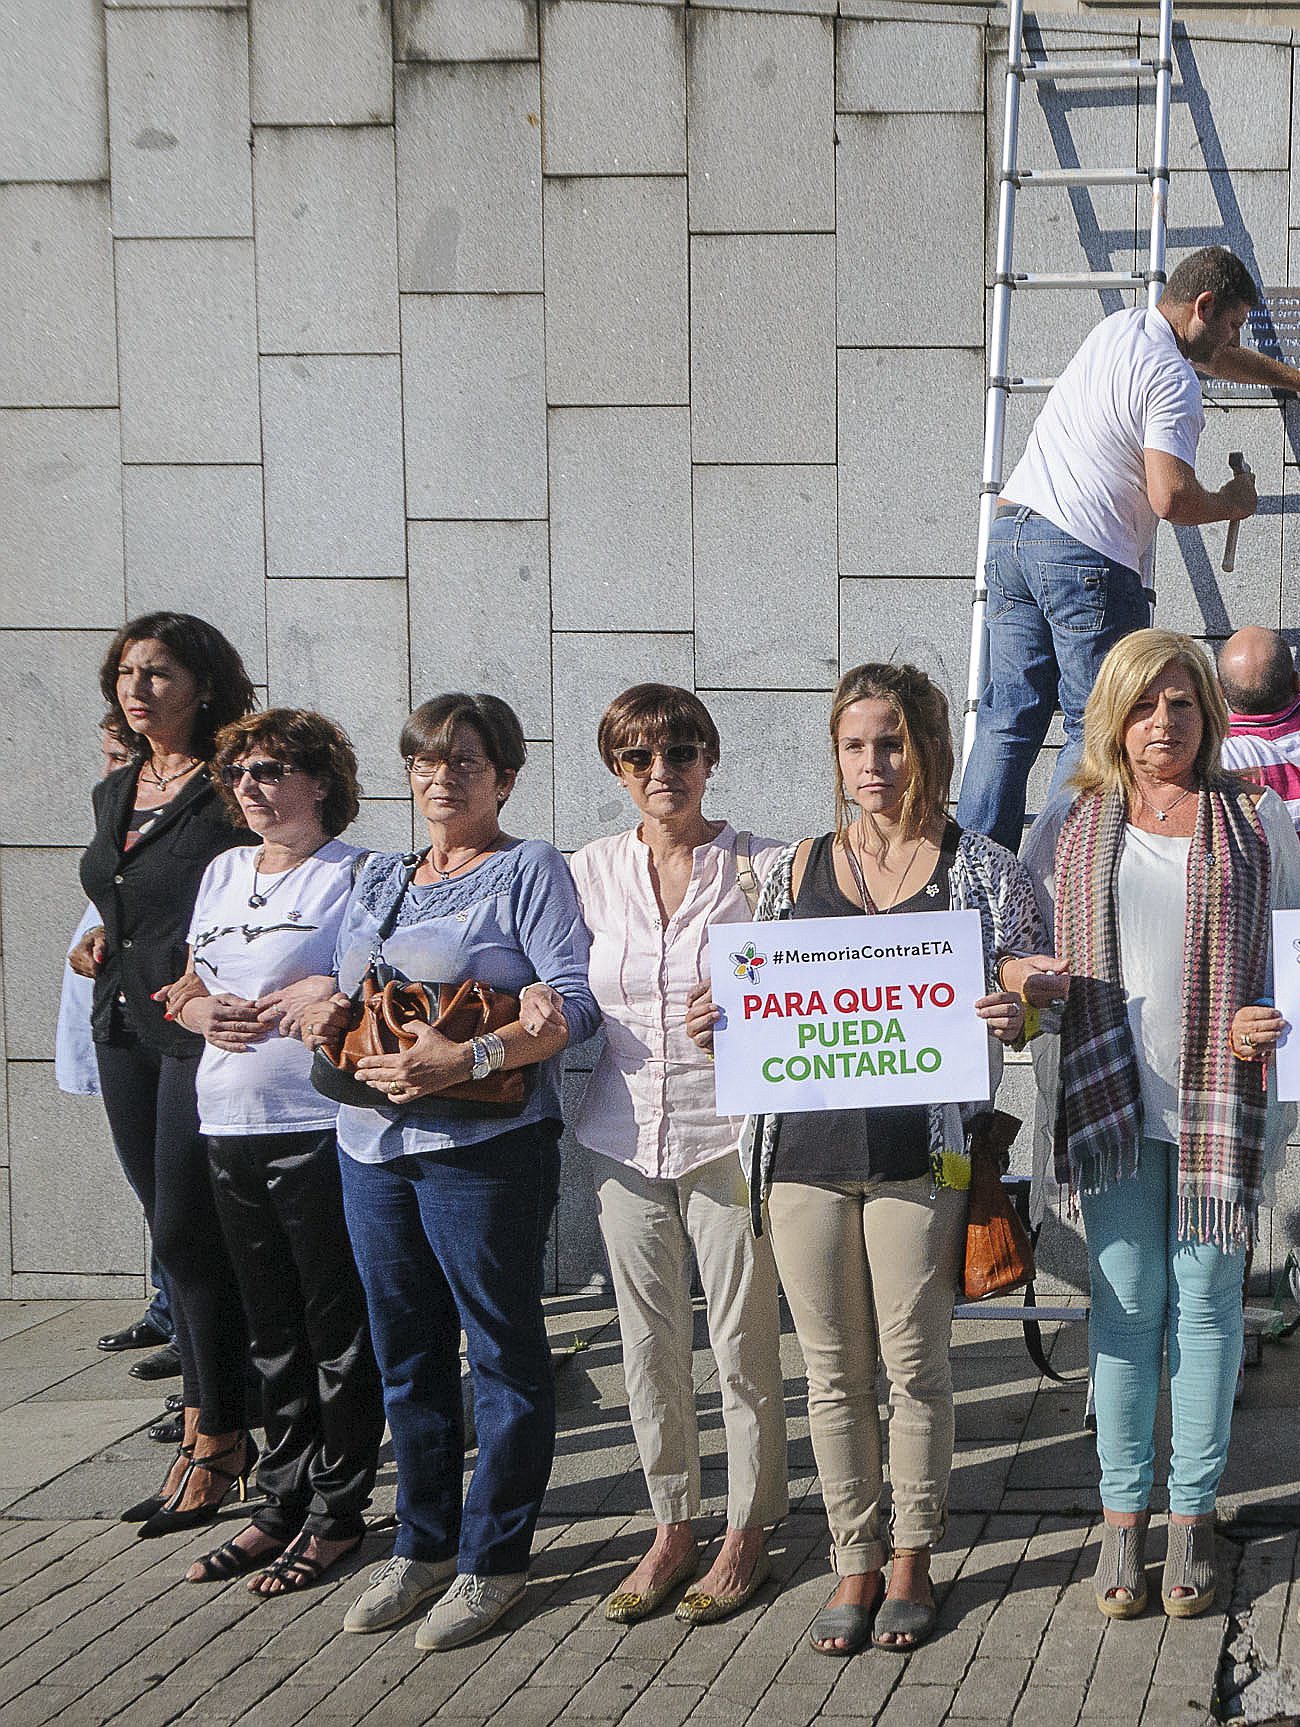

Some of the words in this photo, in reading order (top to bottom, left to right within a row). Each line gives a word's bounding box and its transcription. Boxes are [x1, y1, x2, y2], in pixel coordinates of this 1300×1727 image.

[773, 940, 954, 965] #MemoriaContraETA
[744, 990, 828, 1020] PARA
[834, 985, 903, 1013] QUE
[908, 982, 955, 1009] YO
[798, 1018, 906, 1048] PUEDA
[762, 1046, 942, 1083] CONTARLO
